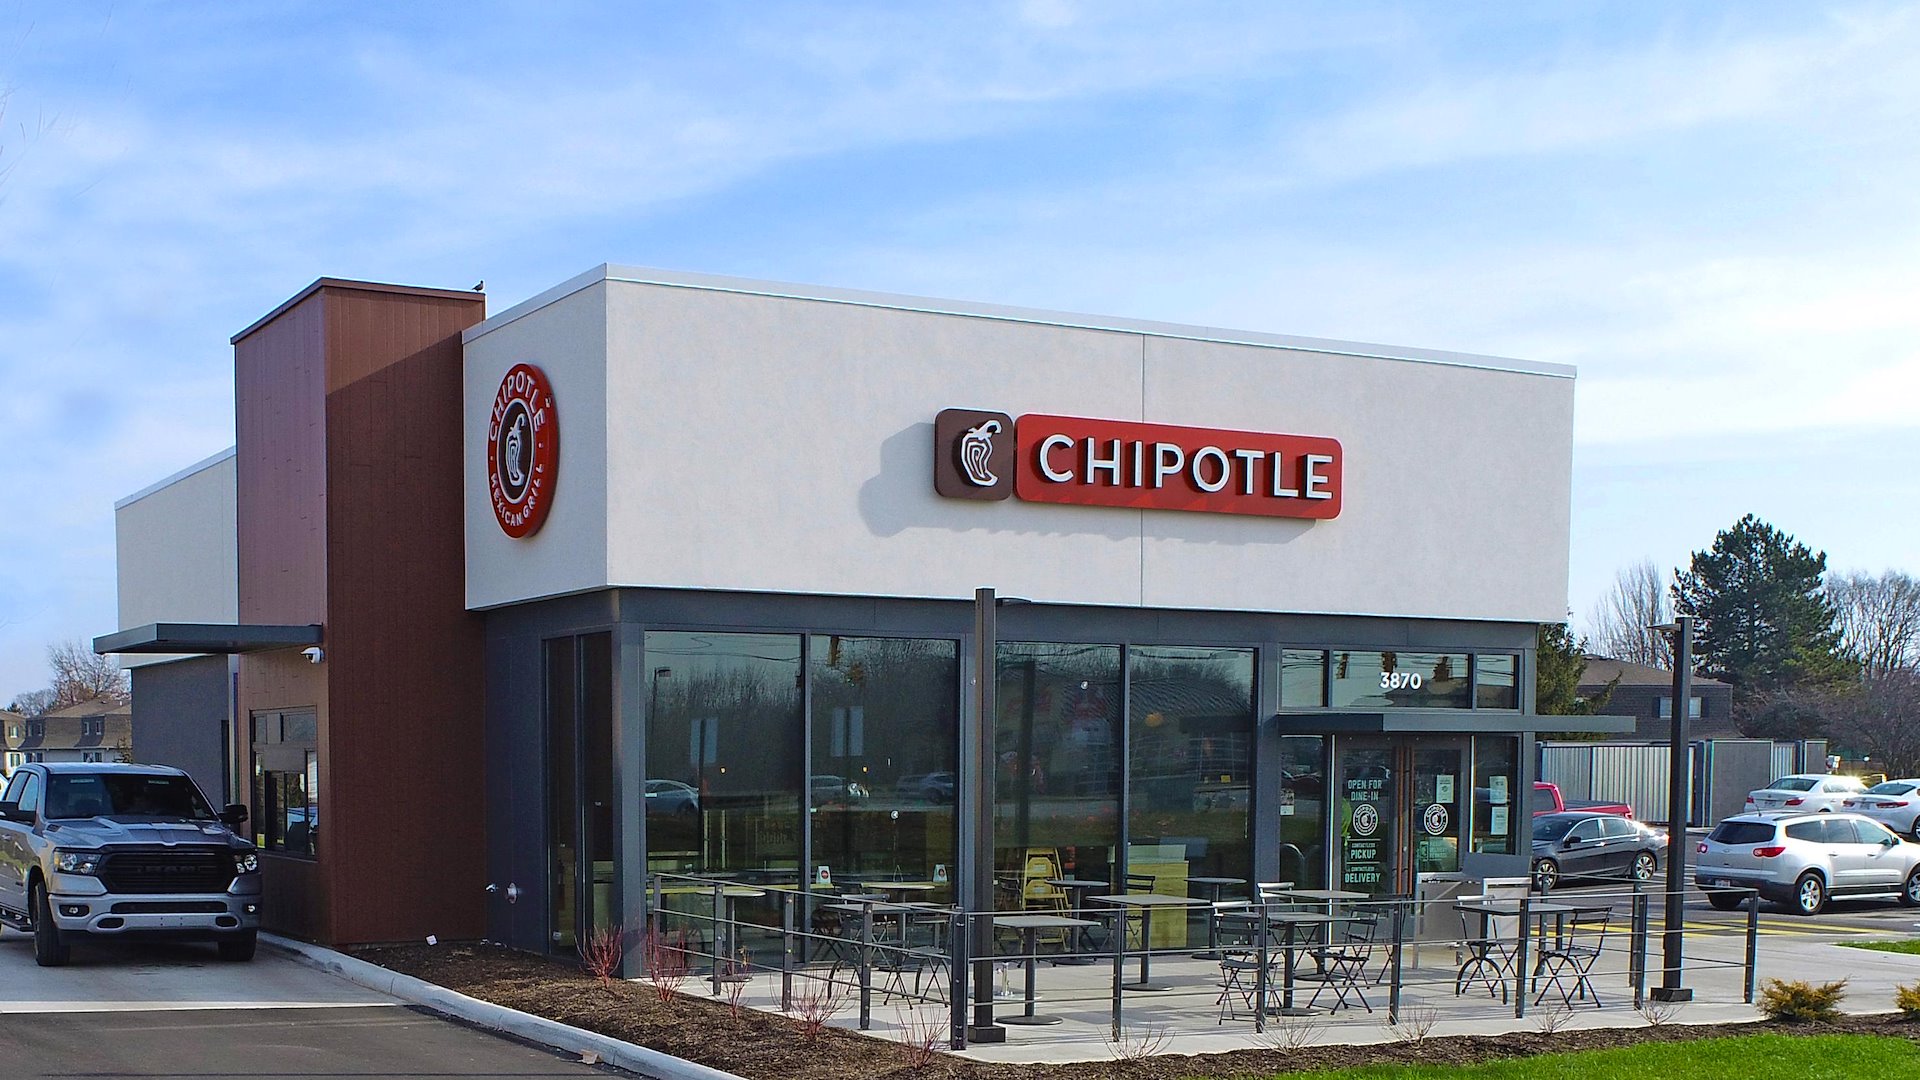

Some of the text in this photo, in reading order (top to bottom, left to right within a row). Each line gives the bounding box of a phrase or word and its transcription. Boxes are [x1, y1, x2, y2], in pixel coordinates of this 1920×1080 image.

[489, 371, 545, 441] CHIPOTLE
[1039, 433, 1333, 499] CHIPOTLE
[491, 464, 544, 526] MEXICAN GRILL
[1380, 671, 1422, 689] 3870
[1347, 780, 1382, 789] OPEN FOR
[1350, 791, 1379, 801] DINE-IN
[1350, 849, 1377, 859] PICKUP
[1344, 872, 1381, 883] DELIVERY
